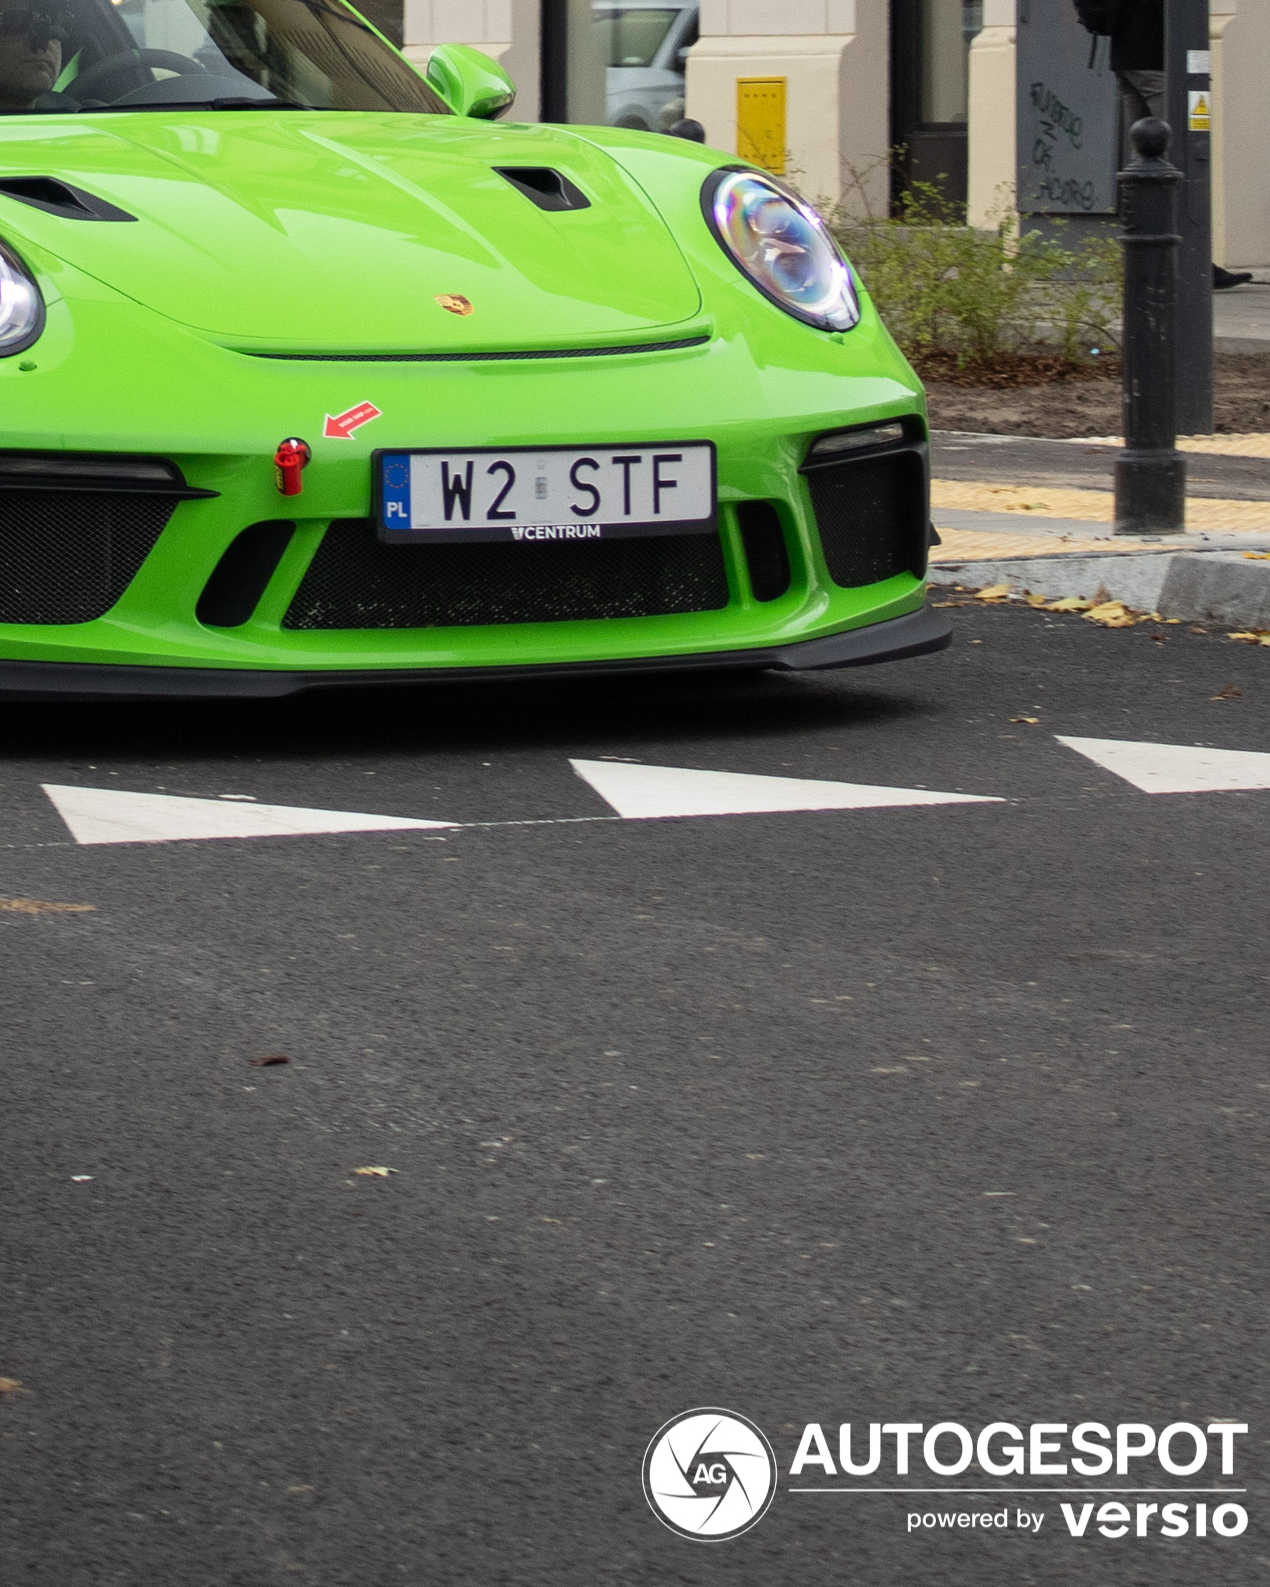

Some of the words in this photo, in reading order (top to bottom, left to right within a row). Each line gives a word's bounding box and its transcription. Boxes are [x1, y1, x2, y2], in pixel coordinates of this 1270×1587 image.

[441, 460, 516, 521] W2
[569, 454, 682, 517] STF
[386, 501, 408, 518] PL
